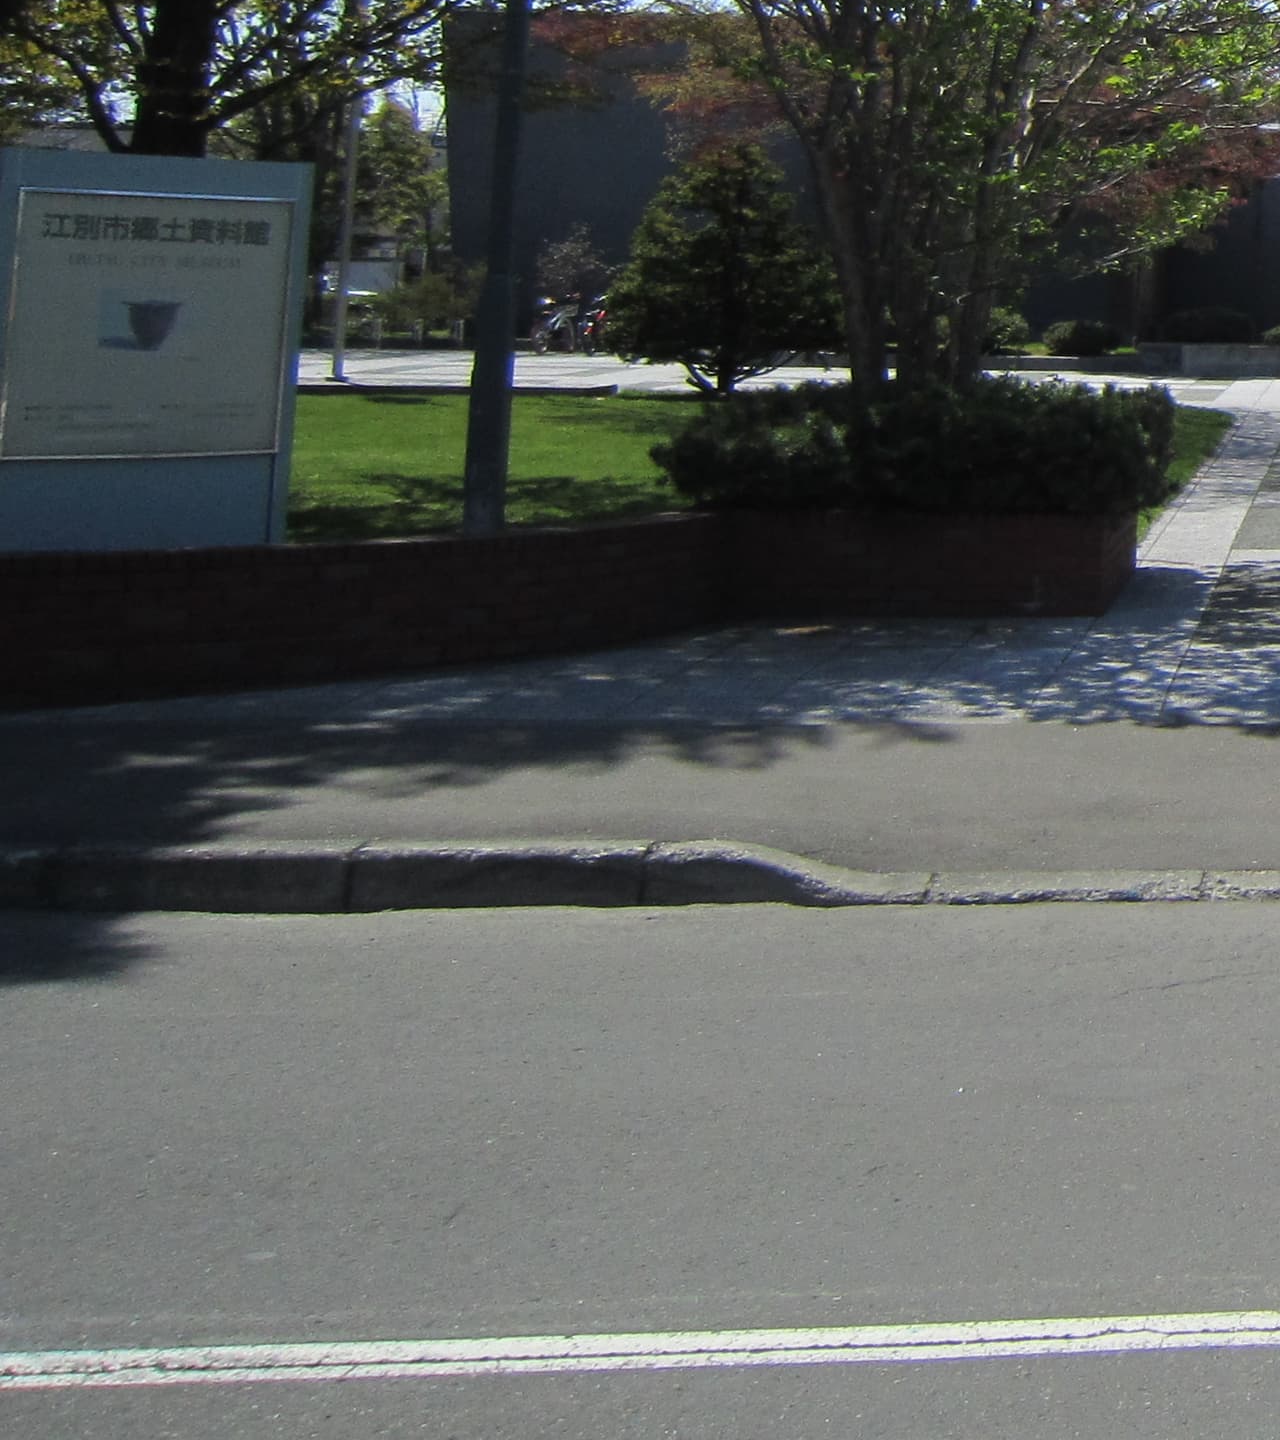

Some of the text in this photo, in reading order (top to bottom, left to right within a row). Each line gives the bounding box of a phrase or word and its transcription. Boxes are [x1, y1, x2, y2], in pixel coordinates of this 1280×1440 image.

[42, 212, 271, 246] 江別市郷土資料館
